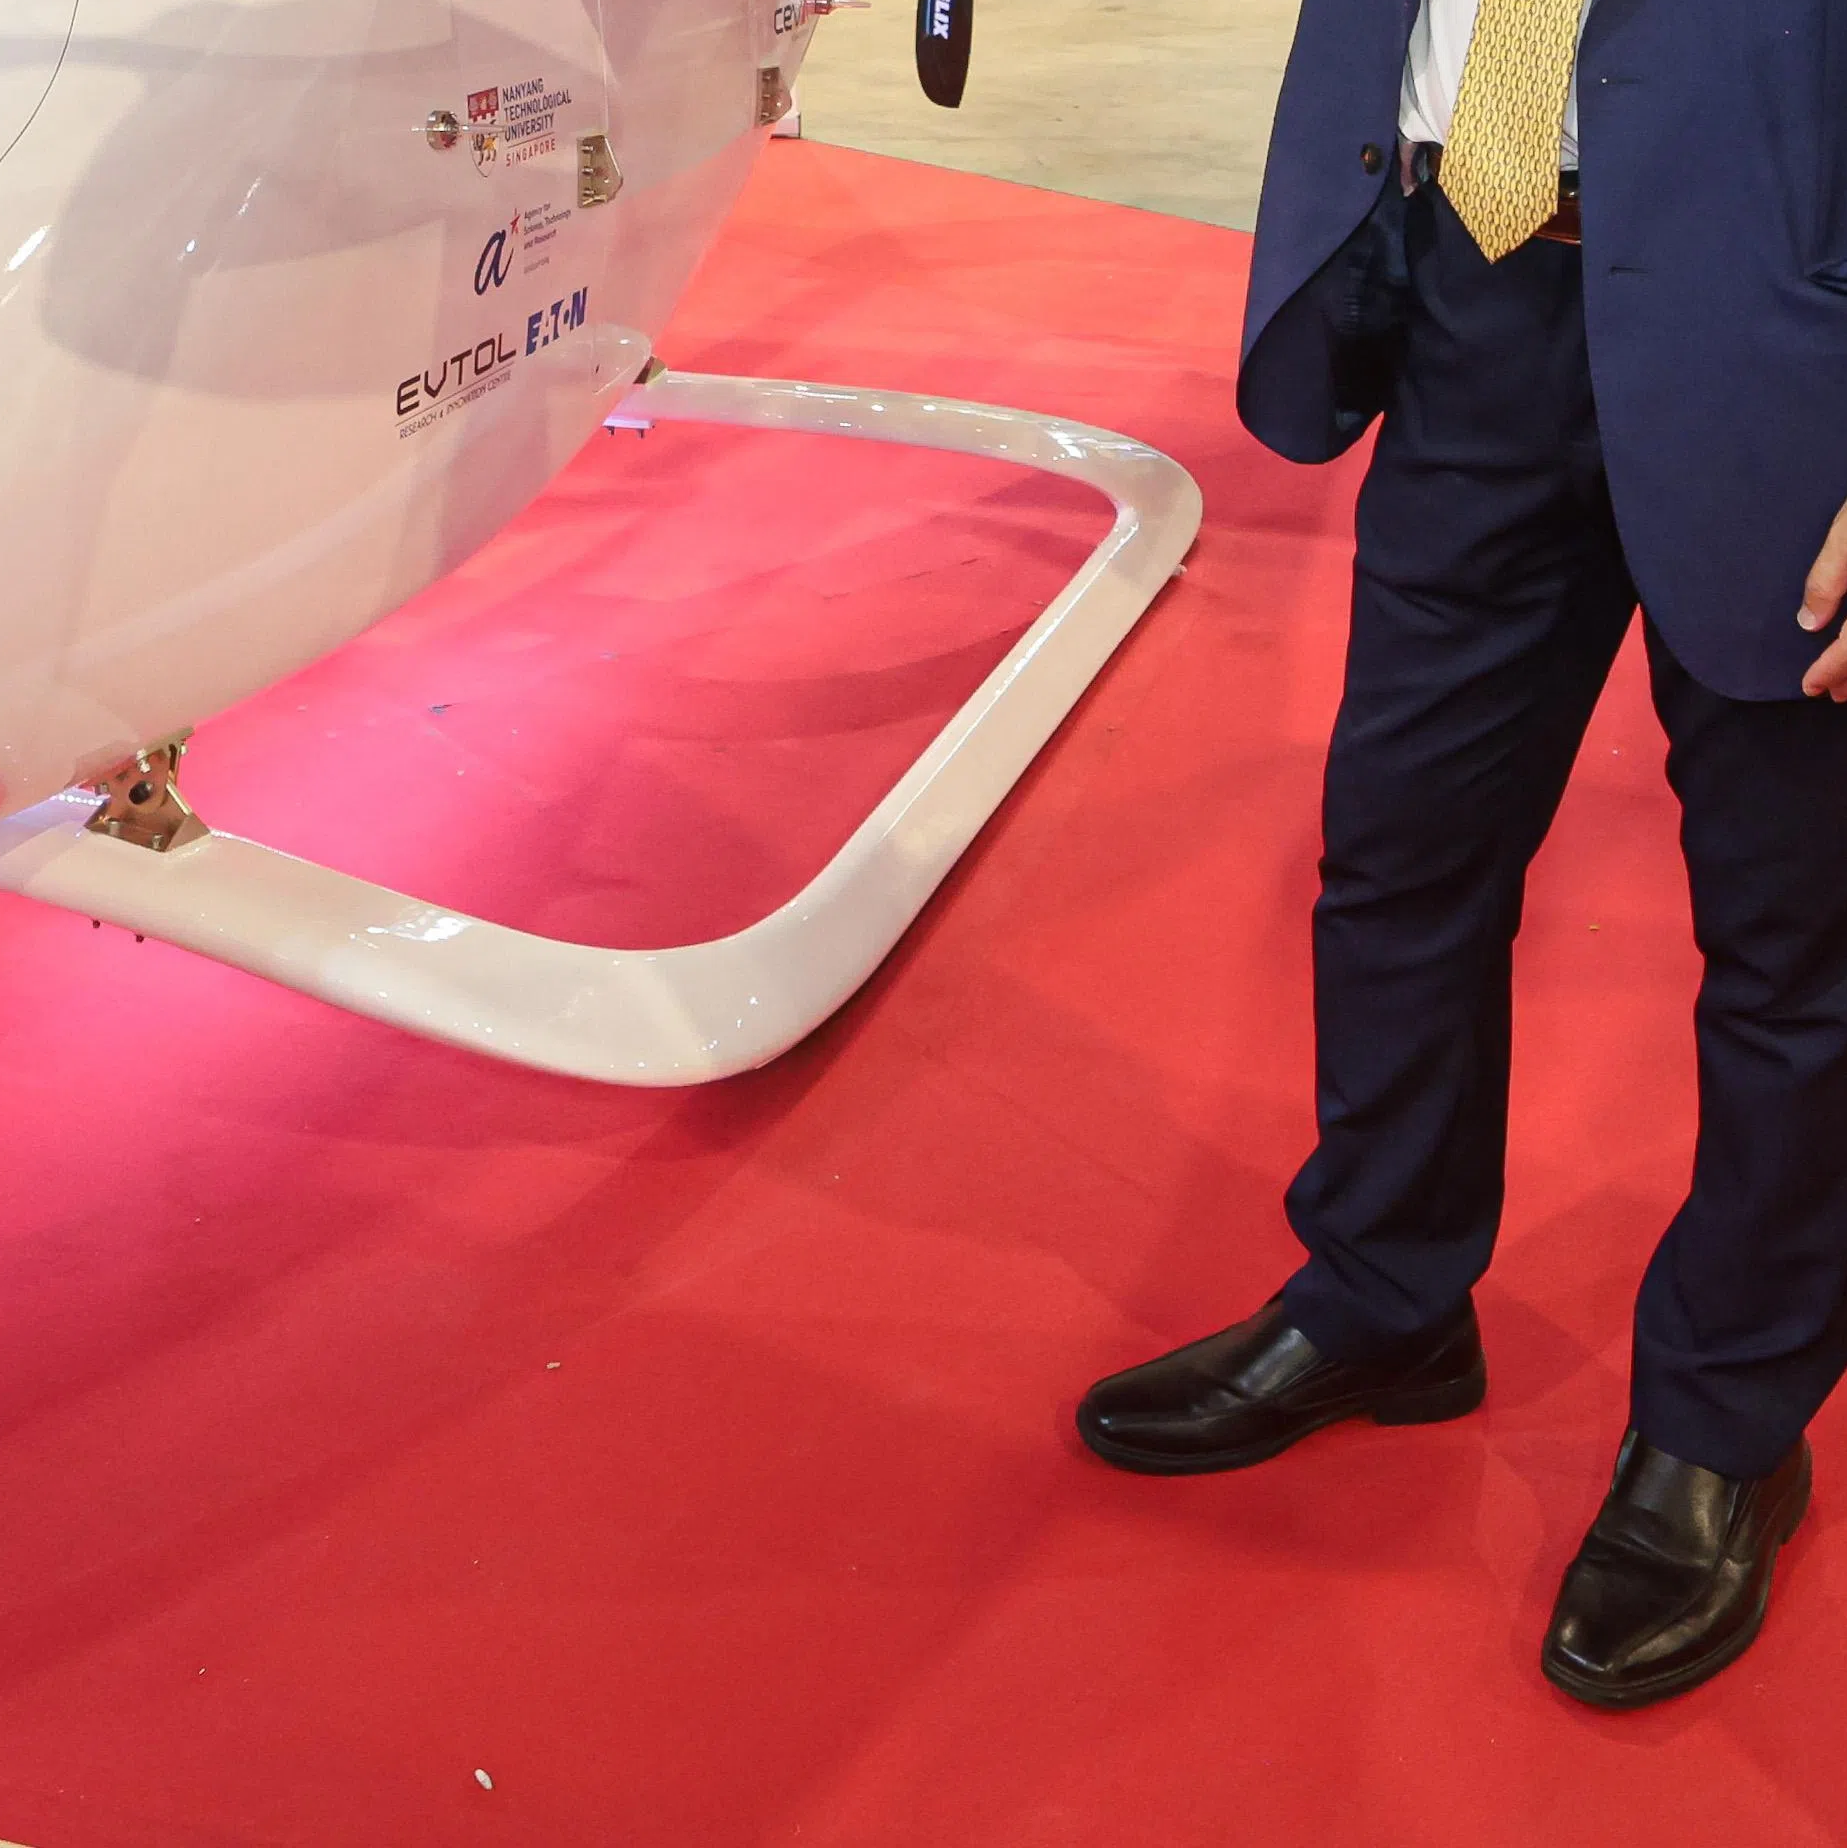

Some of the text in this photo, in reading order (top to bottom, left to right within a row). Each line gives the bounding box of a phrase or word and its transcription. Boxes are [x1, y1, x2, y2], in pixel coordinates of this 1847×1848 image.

[502, 77, 544, 104] NANYANG
[503, 89, 572, 122] TECHNOLOGICAL
[504, 113, 555, 143] UNIVERSITY
[505, 138, 556, 167] SINGAPORE
[396, 332, 517, 417] EVTOL
[399, 411, 437, 440] RESEARCH
